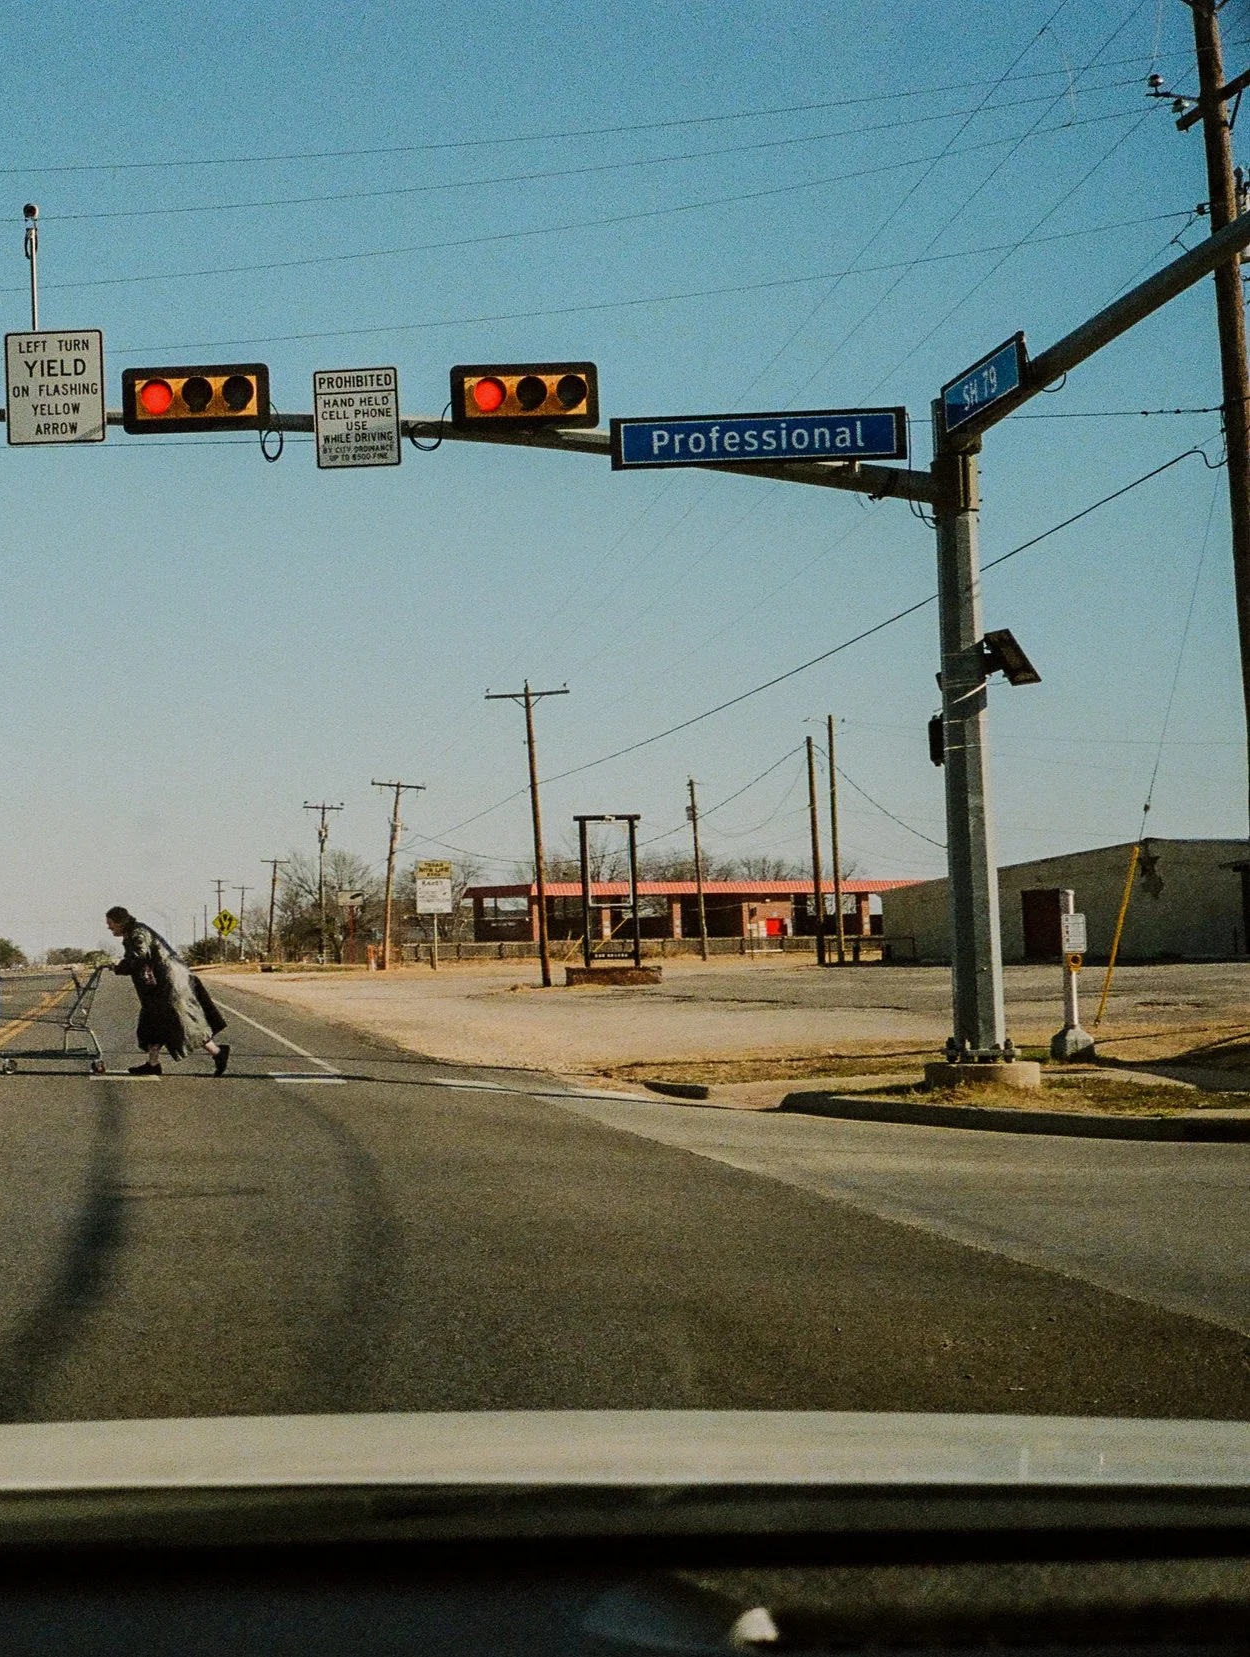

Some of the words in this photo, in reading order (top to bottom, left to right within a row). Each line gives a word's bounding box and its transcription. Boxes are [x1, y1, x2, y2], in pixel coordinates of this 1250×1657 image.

[18, 340, 47, 354] LEFT
[57, 339, 89, 352] TURN
[24, 358, 86, 378] YIELD
[318, 373, 392, 390] PROHIBITED
[12, 385, 29, 398] ON
[38, 382, 98, 397] FLASHING
[323, 397, 355, 408] HAND
[359, 395, 389, 407] HELD
[31, 402, 81, 417] YELLOW
[321, 410, 349, 421] CELL
[354, 407, 392, 419] PHONE
[35, 422, 78, 436] ARROW
[346, 420, 368, 431] USE
[323, 433, 351, 444] WHILE
[355, 431, 393, 443] DRIVING
[651, 420, 865, 455] Professional
